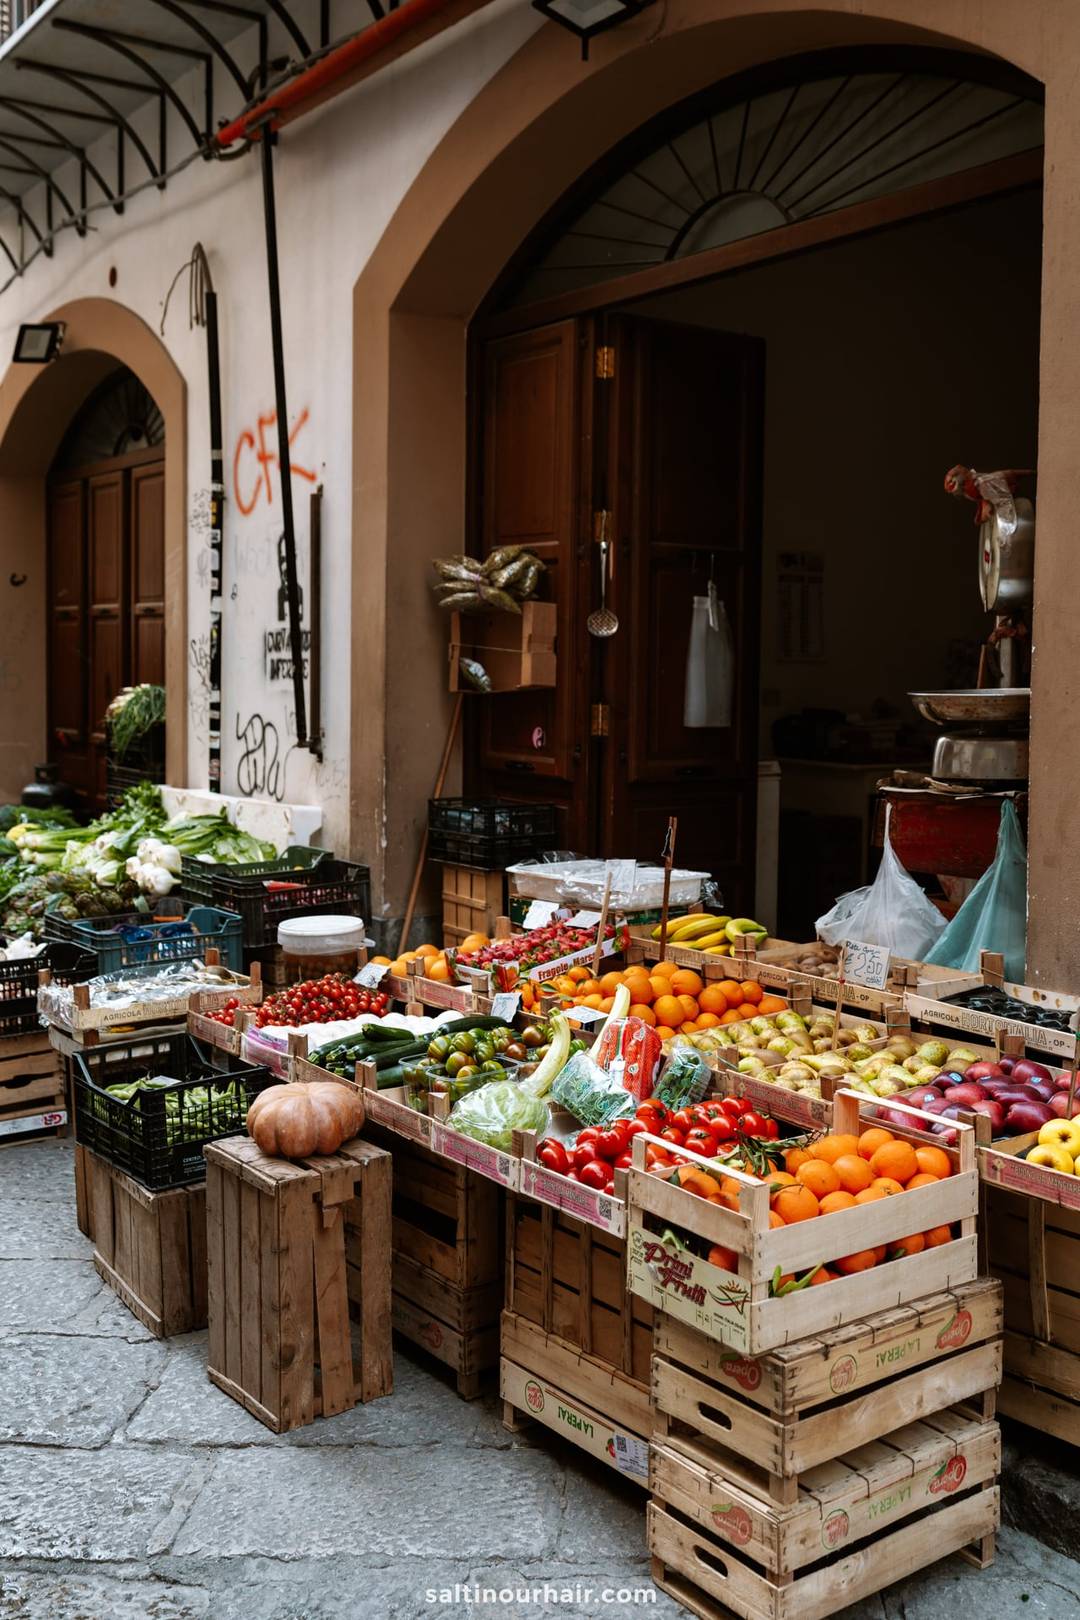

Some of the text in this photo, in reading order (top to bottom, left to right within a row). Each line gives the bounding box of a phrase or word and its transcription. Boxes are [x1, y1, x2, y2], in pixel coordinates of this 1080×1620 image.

[537, 948, 605, 980] Fragole Marsa
[103, 1010, 142, 1021] AGRICOLA
[923, 1009, 960, 1023] AGRICOLA
[582, 1420, 594, 1439] LA
